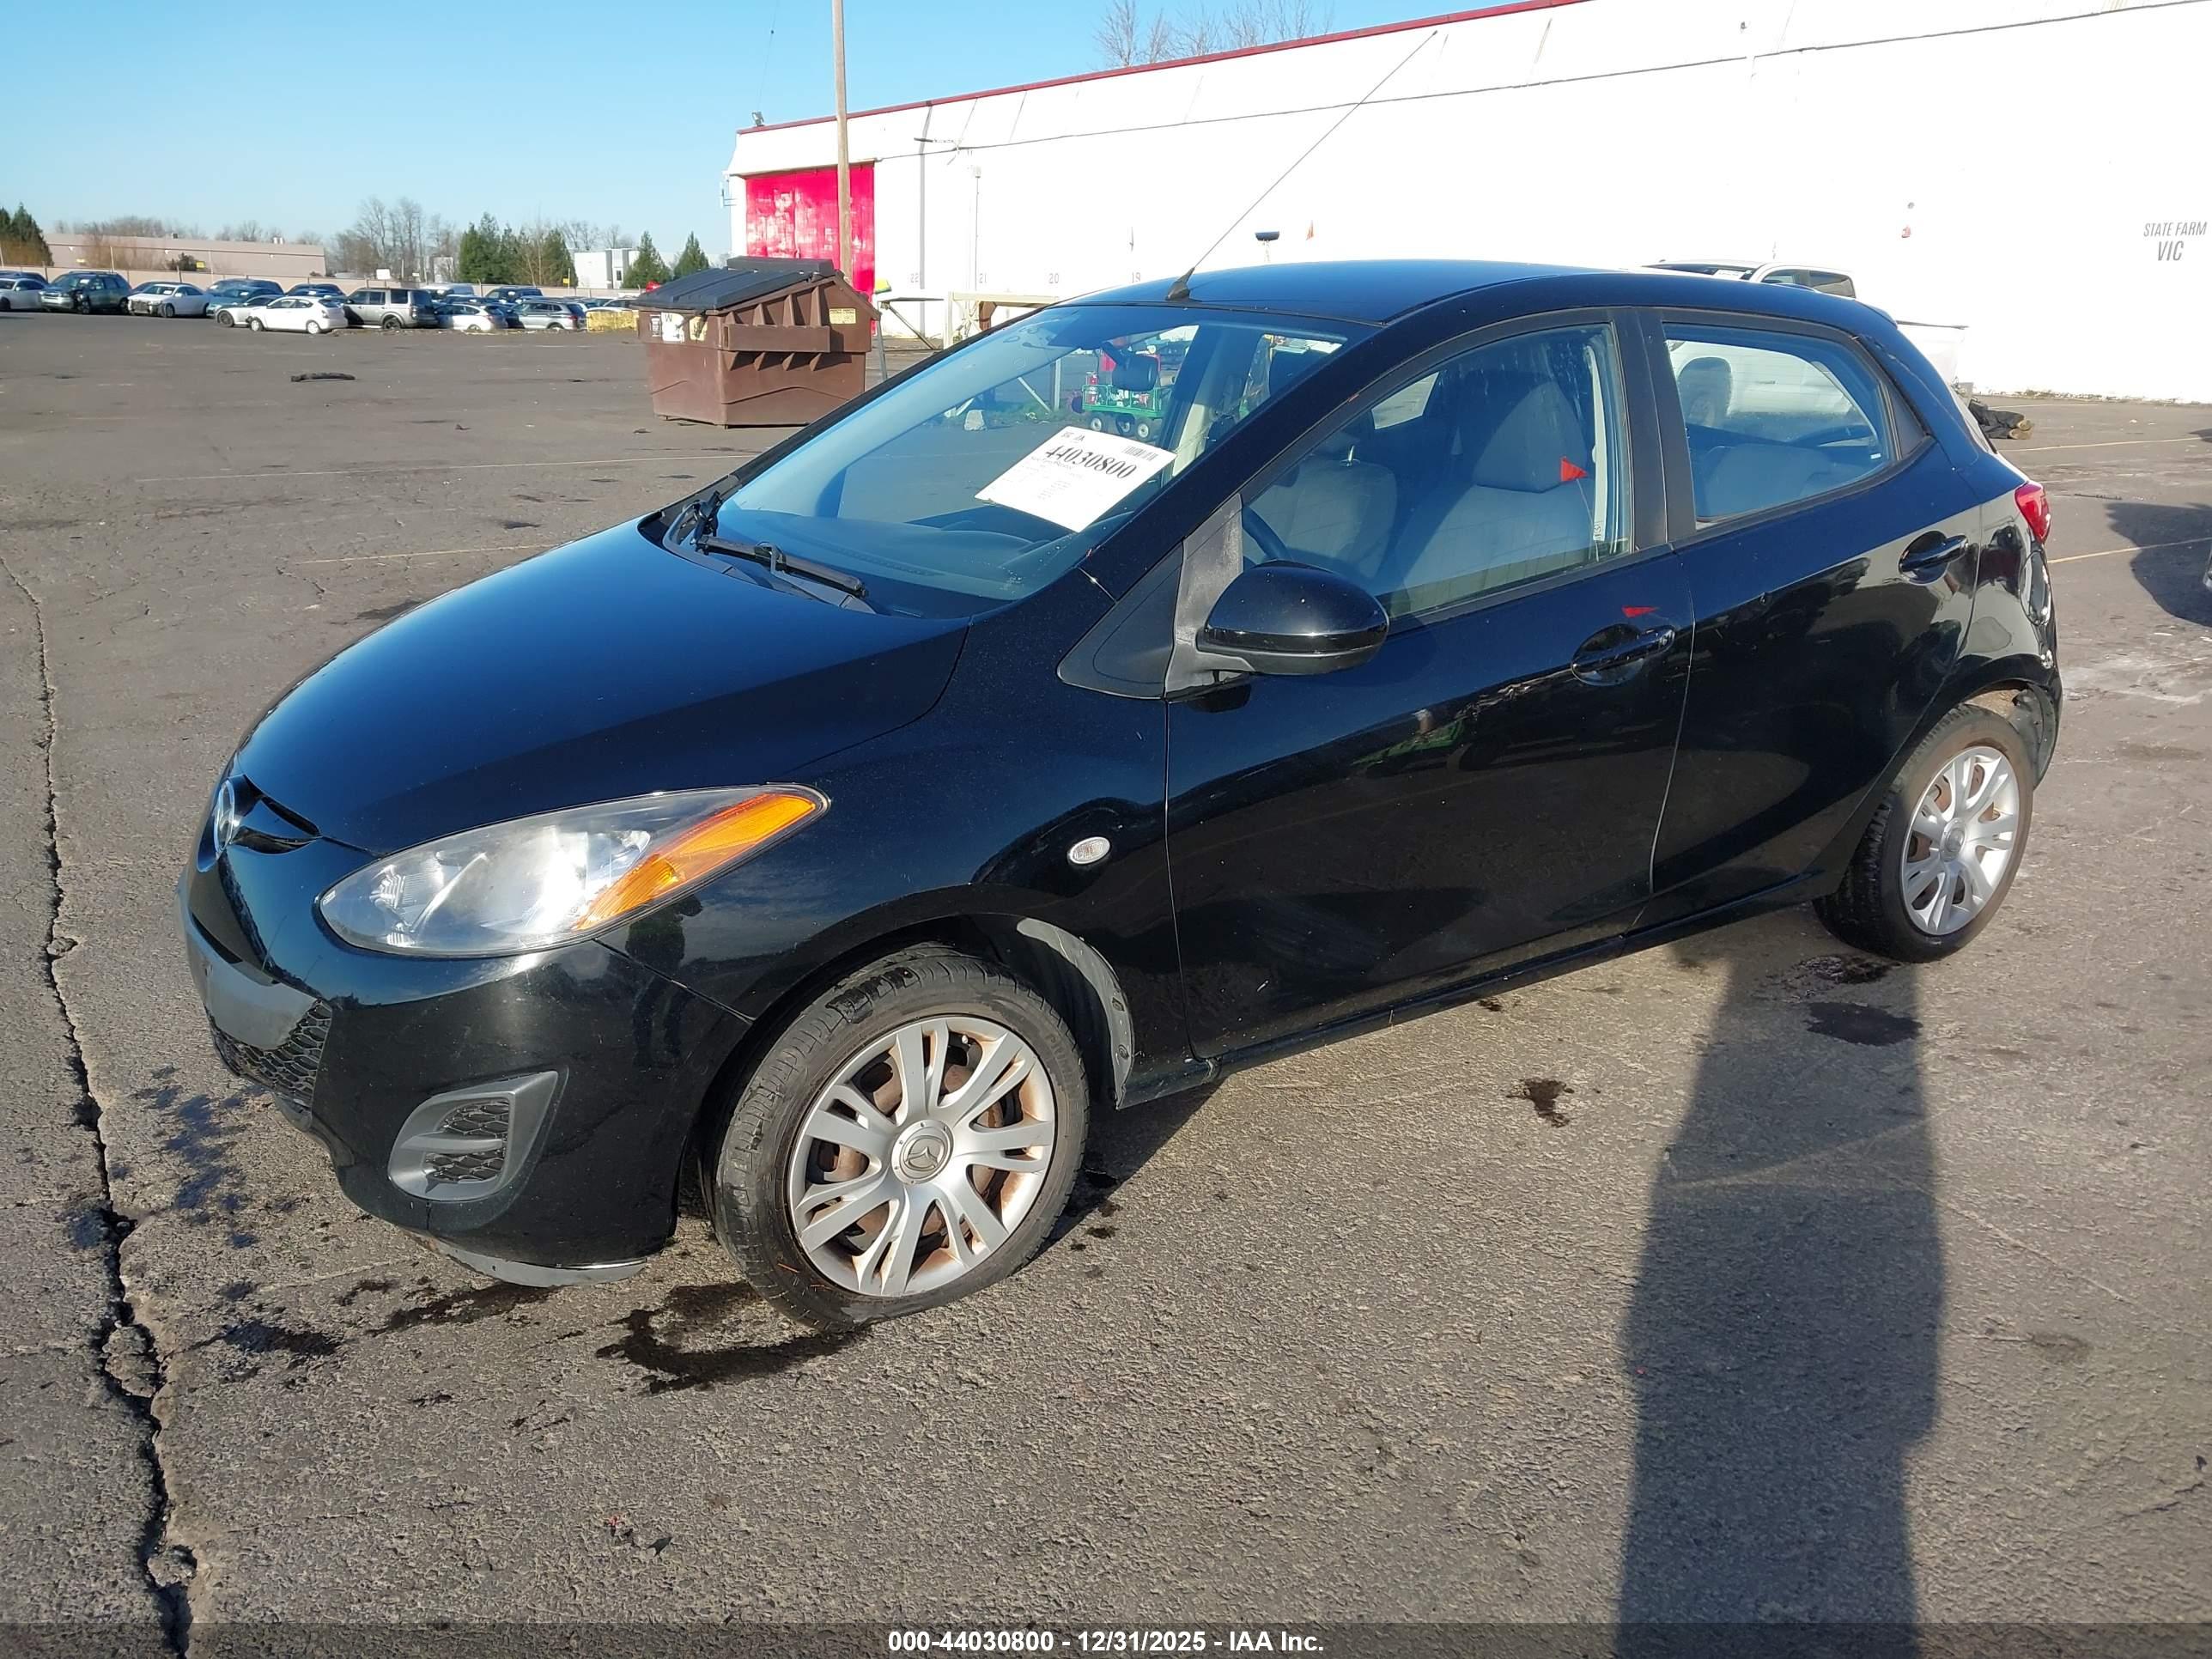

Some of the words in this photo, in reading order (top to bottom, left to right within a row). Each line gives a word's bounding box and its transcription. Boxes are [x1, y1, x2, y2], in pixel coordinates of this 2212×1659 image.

[2143, 222, 2173, 237] STATE
[2174, 221, 2208, 236] FARM
[2158, 240, 2185, 261] VIC
[979, 272, 988, 283] 21
[1048, 272, 1060, 284] 20
[1045, 445, 1138, 479] 44030800
